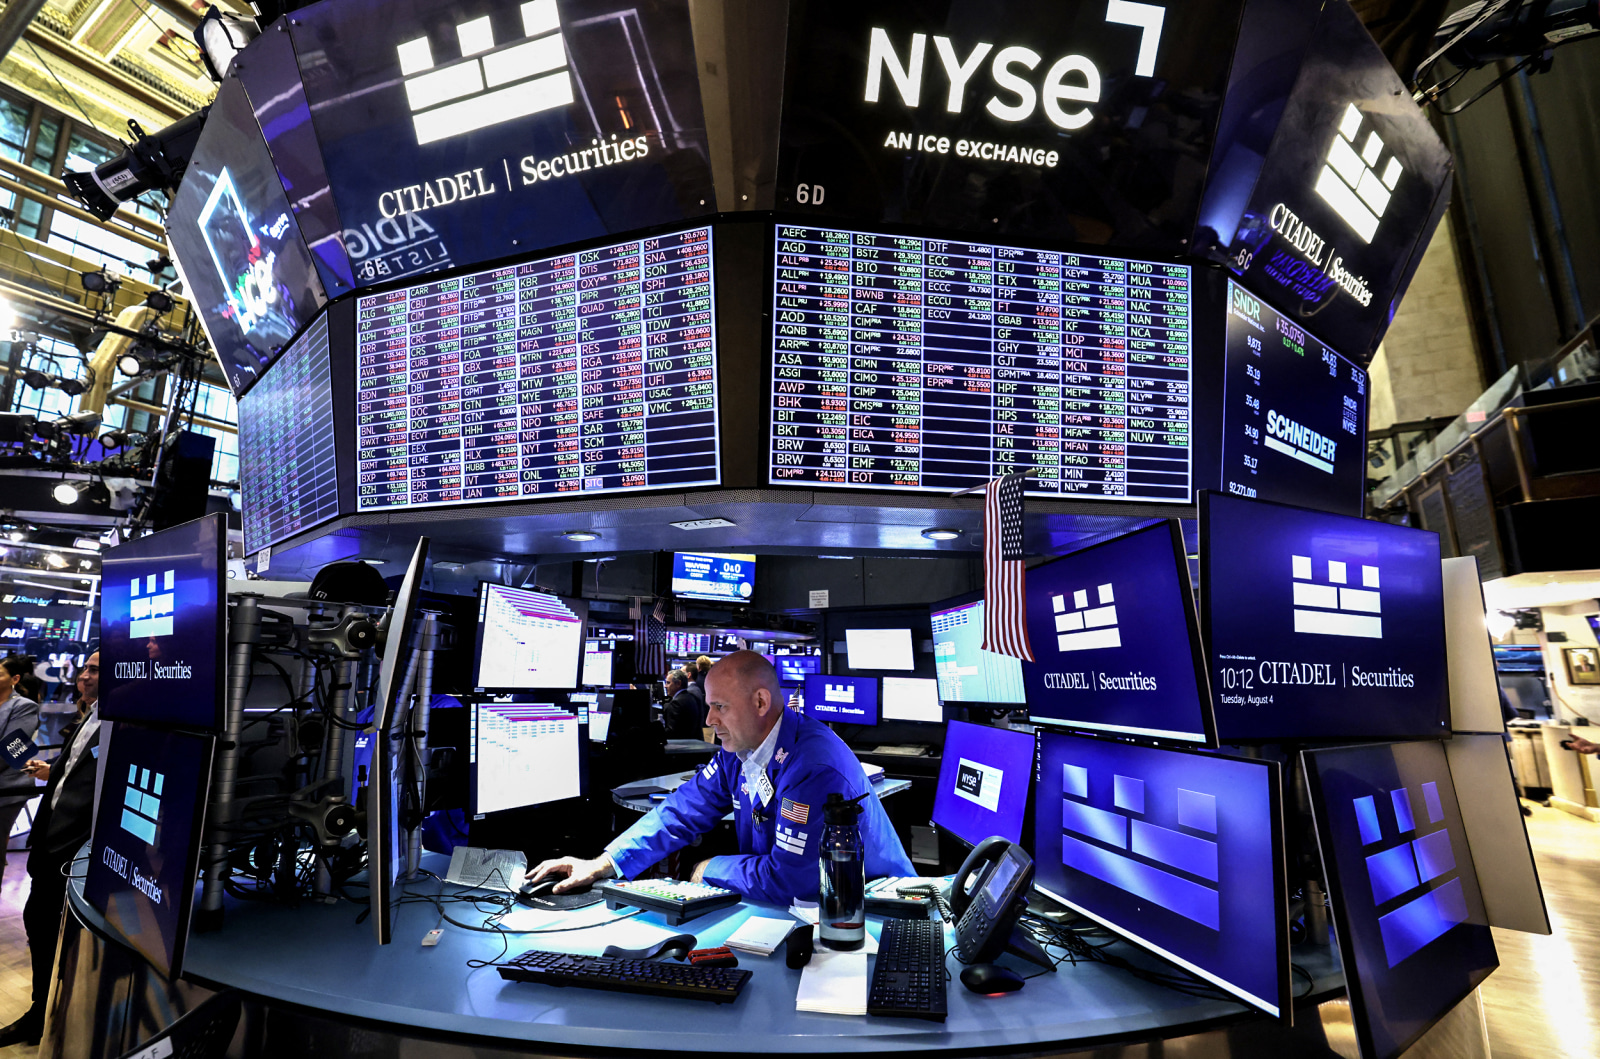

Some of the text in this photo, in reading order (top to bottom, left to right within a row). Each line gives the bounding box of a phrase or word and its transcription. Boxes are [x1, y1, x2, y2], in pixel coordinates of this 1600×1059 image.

[884, 131, 912, 149] AN
[378, 134, 649, 219] CITADEL Securities
[796, 183, 825, 205] 6D
[782, 227, 806, 237] AEFC
[645, 239, 658, 250] SM
[857, 234, 876, 245] BST
[782, 241, 805, 252] AGD
[928, 241, 947, 252] DTF
[580, 250, 599, 263] OSK
[645, 251, 666, 263] SNA
[856, 248, 878, 258] BSTZ
[1270, 203, 1373, 307] CITADEL Securities
[1065, 256, 1079, 265] JRI
[1237, 248, 1253, 270] 6C
[519, 264, 533, 274] JILL
[580, 264, 597, 274] OTIS
[646, 264, 666, 277] SON
[856, 261, 877, 272] BTO
[1130, 262, 1152, 273] MMD
[463, 276, 475, 286] ESI
[520, 276, 537, 287] KBR
[646, 278, 665, 290] SPH
[856, 275, 875, 286] BTT
[998, 275, 1016, 285] ETX
[1130, 275, 1151, 286] MUA
[410, 286, 428, 296] CARR
[928, 282, 950, 291] ECCC
[463, 287, 479, 299] EVC
[646, 292, 664, 304] SXT
[410, 298, 426, 309] CBU
[581, 302, 604, 313] QUAD
[855, 303, 877, 313] CAF
[998, 302, 1010, 311] FT
[1130, 301, 1150, 311] NAC
[1233, 288, 1260, 321] SNDR
[780, 311, 804, 322] AOD
[928, 309, 950, 318] ECCV
[520, 314, 537, 325] LEG
[647, 318, 670, 330] TDW
[997, 315, 1021, 325] GBAB
[779, 325, 806, 335] AQNB
[1065, 321, 1078, 330] KF
[361, 331, 376, 341] APH
[520, 326, 542, 337] MAGN
[1130, 327, 1150, 337] NCA
[647, 333, 667, 344] TKR
[1065, 334, 1084, 344] LDP
[582, 356, 602, 367] RGA
[779, 353, 802, 364] ASA
[854, 358, 877, 368] CIMN
[648, 360, 672, 371] TWO
[778, 367, 800, 377] ASGI
[464, 374, 478, 384] GIC
[649, 387, 671, 398] USAC
[778, 382, 804, 392] AWP
[854, 386, 876, 395] CIMP
[997, 382, 1017, 393] HPF
[411, 394, 423, 405] DEI
[521, 391, 540, 402] MYE
[583, 396, 603, 407] RPM
[778, 396, 801, 407] BHK
[361, 403, 371, 412] BH
[649, 401, 671, 413] VMC
[583, 409, 603, 419] SAFE
[778, 410, 795, 421] BIT
[522, 417, 541, 428] NPO
[1130, 419, 1154, 428] NMCO
[464, 424, 482, 434] HHH
[777, 424, 799, 435] BKT
[853, 429, 874, 438] EICA
[997, 423, 1013, 434] IAE
[1131, 432, 1154, 442] NUW
[1266, 409, 1336, 462] SCHNEIDER
[584, 436, 603, 447] SCM
[522, 443, 540, 453] NYT
[996, 451, 1014, 461] JCE
[1064, 455, 1088, 464] MFAO
[465, 462, 484, 471] HUBB
[1064, 468, 1082, 478] MIN
[465, 488, 482, 498] JAN
[523, 483, 538, 493] ORI
[361, 497, 377, 505] CALX
[412, 492, 428, 502] EQR
[114, 660, 192, 680] CITADEL Securities
[1259, 660, 1415, 688] CITADEL Securities
[1043, 671, 1157, 691] CITADEL Securities
[1220, 667, 1254, 689] 10:12
[1220, 694, 1274, 706] Tuesday, August 4
[815, 704, 838, 713] CITADEL
[103, 845, 163, 905] CITADEL Securities
